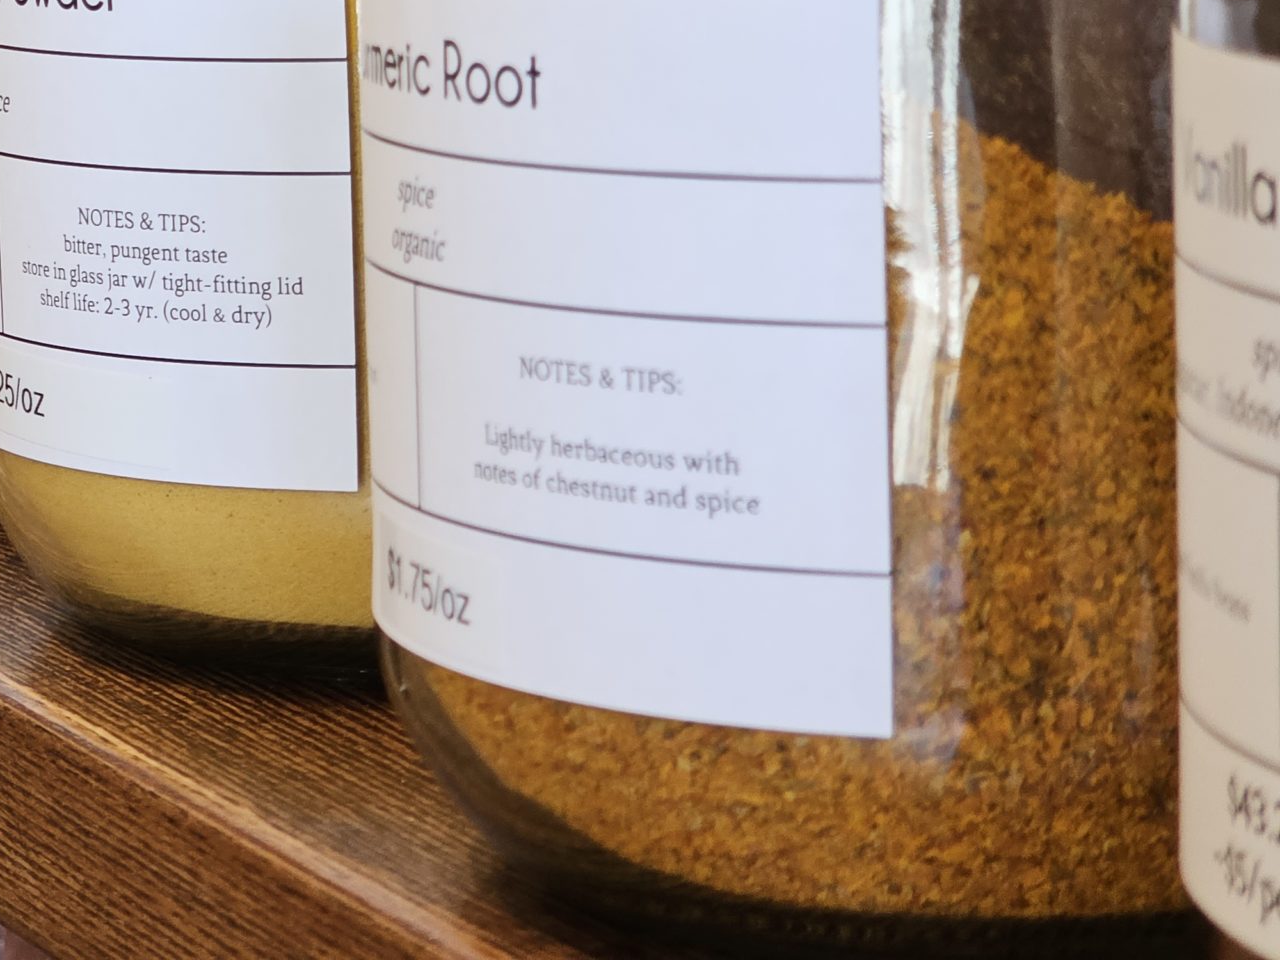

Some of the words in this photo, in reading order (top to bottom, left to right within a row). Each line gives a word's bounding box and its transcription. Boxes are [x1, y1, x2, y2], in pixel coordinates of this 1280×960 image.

[443, 39, 542, 110] Root
[397, 176, 435, 213] spice
[78, 206, 135, 230] NOTES
[139, 212, 154, 231] &
[158, 212, 207, 234] TIPS:
[63, 234, 107, 259] bitter,
[110, 244, 180, 266] pungent
[185, 246, 229, 264] taste
[391, 229, 446, 264] organic
[22, 259, 50, 279] store
[53, 262, 67, 281] in
[69, 263, 104, 288] glass
[107, 267, 128, 291] jar
[132, 270, 157, 291] w/
[162, 273, 272, 301] tight-fitting
[277, 276, 304, 296] lid
[40, 288, 70, 310] shelf
[72, 291, 100, 314] life:
[104, 297, 131, 317] 2-3
[135, 303, 158, 324] yr.
[163, 299, 207, 324] (cool
[212, 307, 226, 323] &
[231, 303, 273, 330] dry)
[519, 355, 593, 388] NOTES
[598, 367, 615, 390] &
[621, 367, 683, 396] TIPS:
[484, 421, 545, 462] Lightly
[550, 433, 676, 473] herbaceous
[683, 450, 740, 477] with
[474, 460, 518, 487] notes
[521, 467, 542, 490] of
[546, 471, 639, 505] chestnut
[644, 485, 689, 511] and
[695, 489, 761, 520] spice
[387, 544, 471, 627] $1.75/oz
